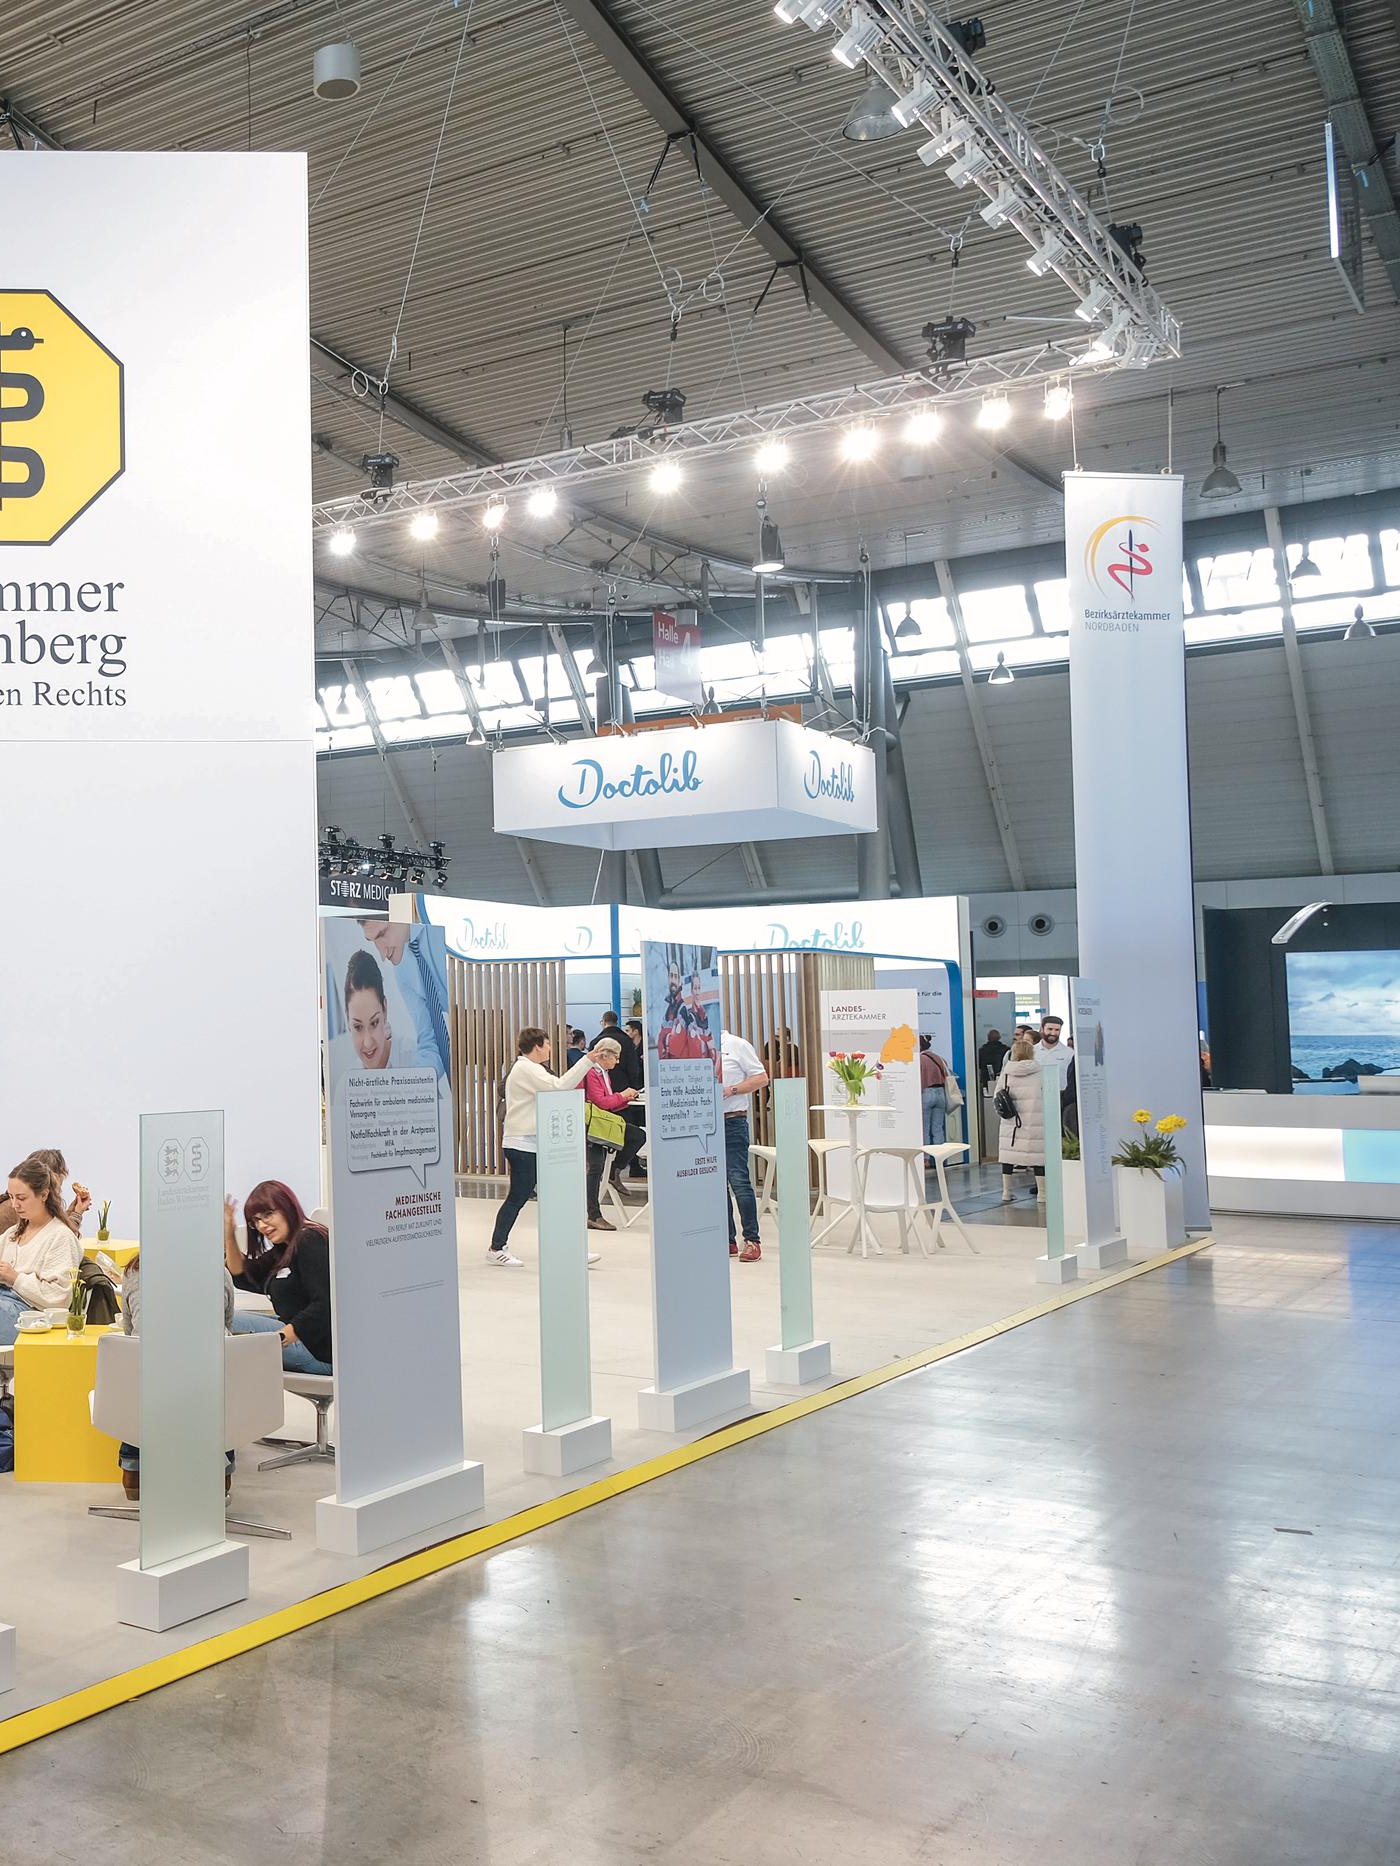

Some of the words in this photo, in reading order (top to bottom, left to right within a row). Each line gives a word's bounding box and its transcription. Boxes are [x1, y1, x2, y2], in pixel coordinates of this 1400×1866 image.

[1084, 608, 1171, 621] Bezirksärztekammer
[658, 621, 679, 644] Halle
[1085, 622, 1140, 632] NORDBADEN
[32, 681, 127, 706] Rechts
[558, 750, 703, 809] Doctolib
[803, 750, 855, 802] Doctolib
[831, 1005, 866, 1013] LANDES-
[349, 1076, 389, 1087] Nicht-ärztliche
[395, 1191, 441, 1206] MEDIZINISCHE
[385, 1204, 442, 1220] FACHANGESTELLTE
